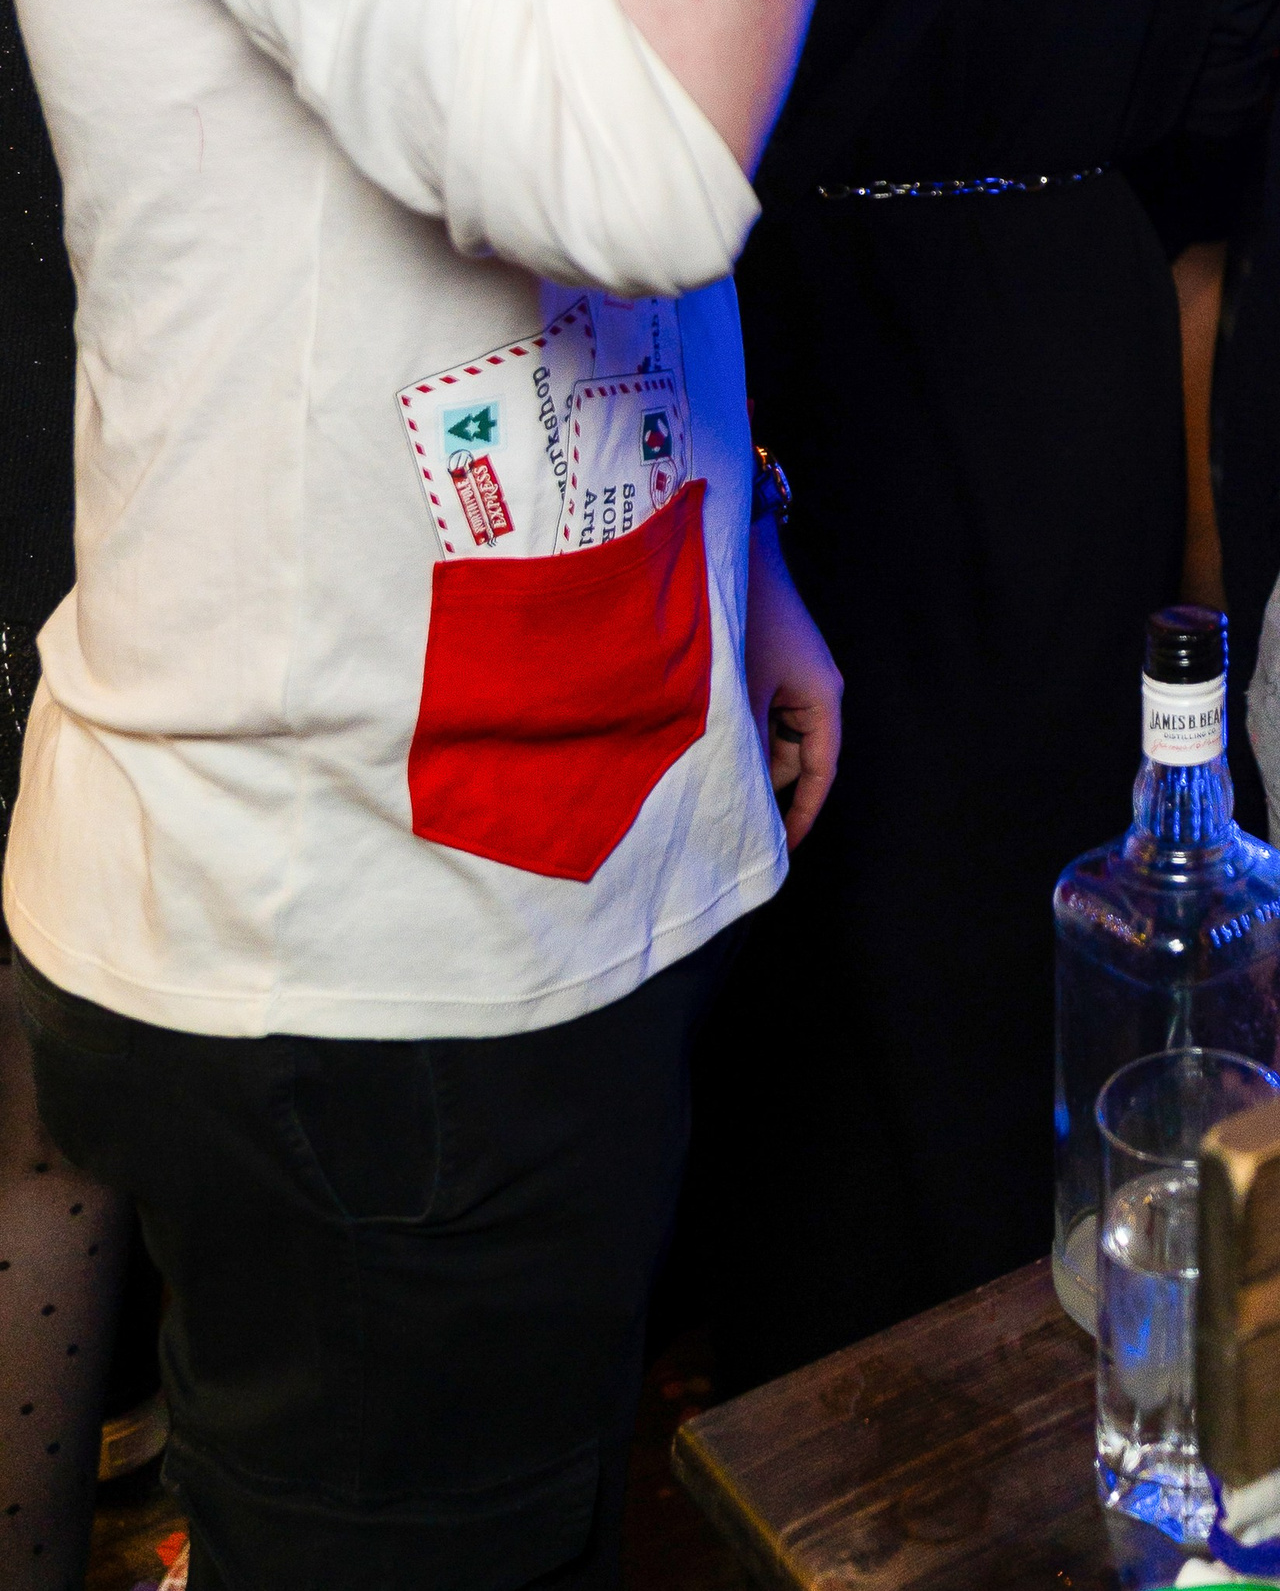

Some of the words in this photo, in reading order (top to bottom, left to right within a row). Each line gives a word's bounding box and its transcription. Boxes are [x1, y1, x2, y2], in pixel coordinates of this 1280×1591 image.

[473, 465, 507, 529] EXPRESS
[1149, 709, 1185, 730] JAMES
[1163, 731, 1207, 740] DISTILLING
